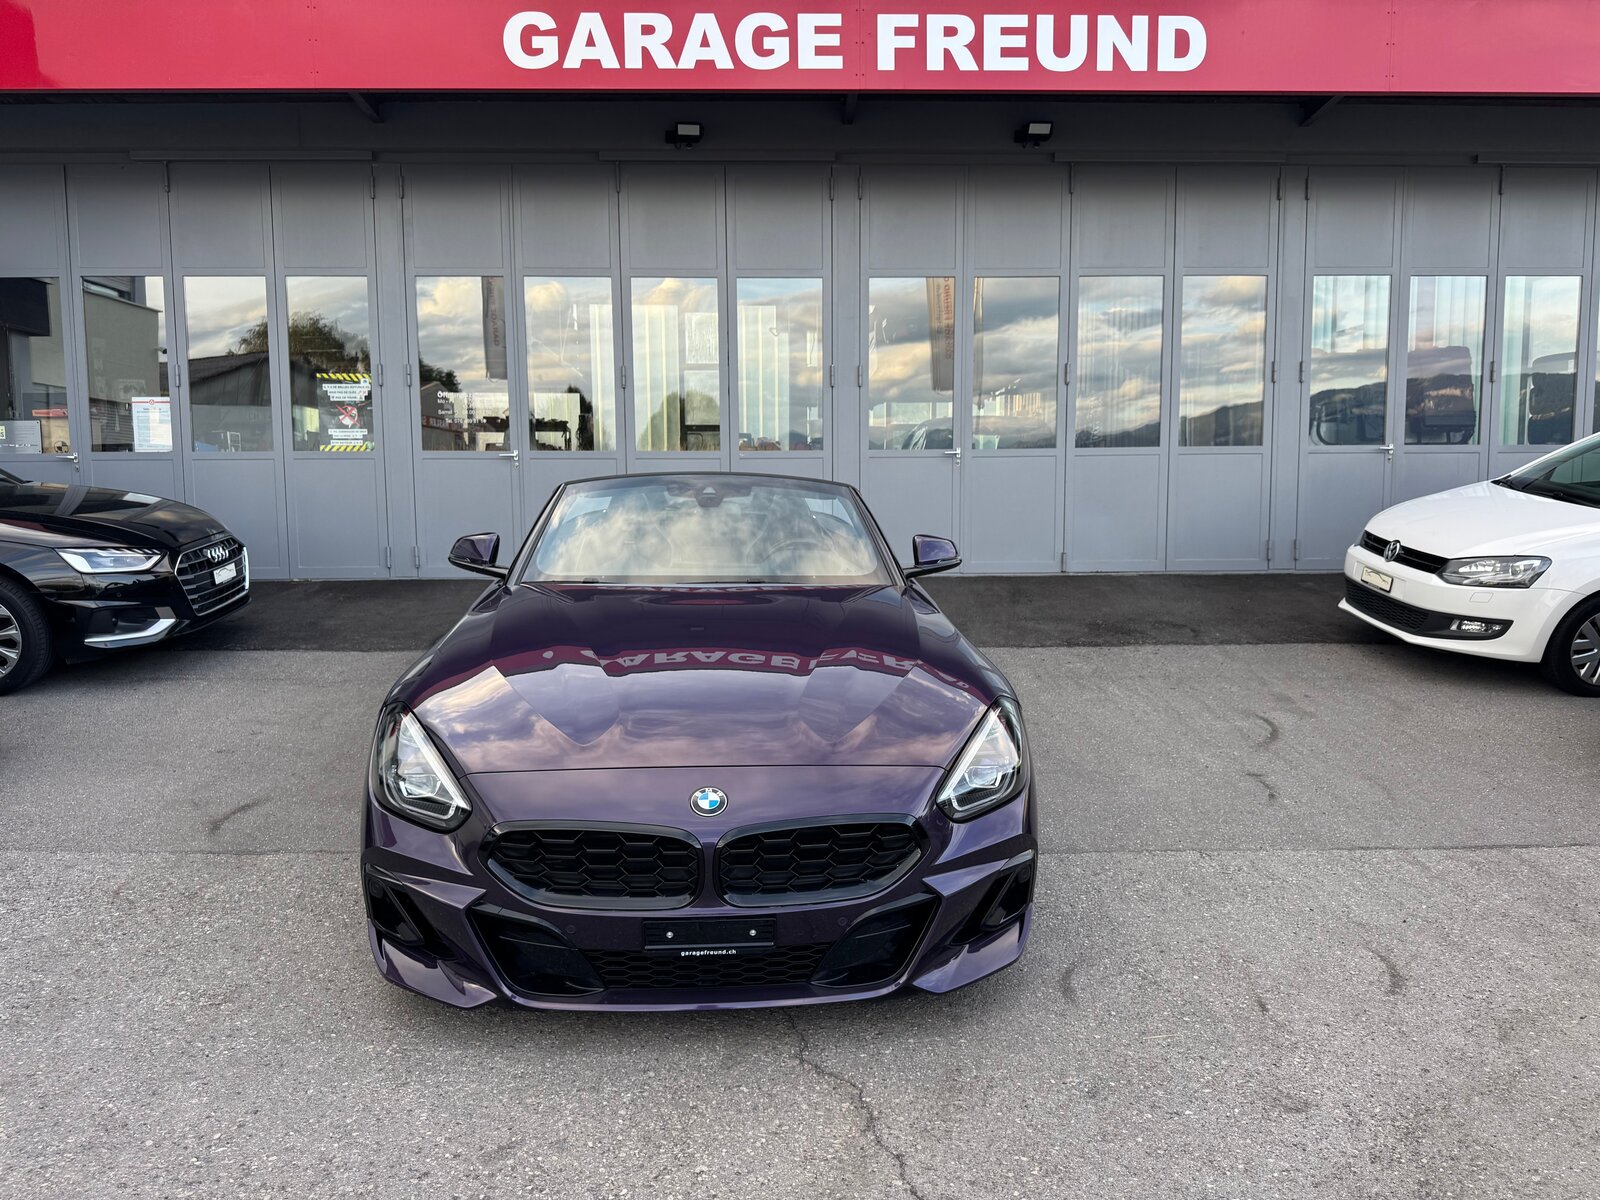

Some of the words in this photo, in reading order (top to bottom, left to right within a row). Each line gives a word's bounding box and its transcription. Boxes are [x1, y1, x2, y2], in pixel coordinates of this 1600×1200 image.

[502, 11, 844, 71] GARAGE
[876, 13, 1208, 73] FREUND
[680, 949, 737, 957] garagefreund.ch
